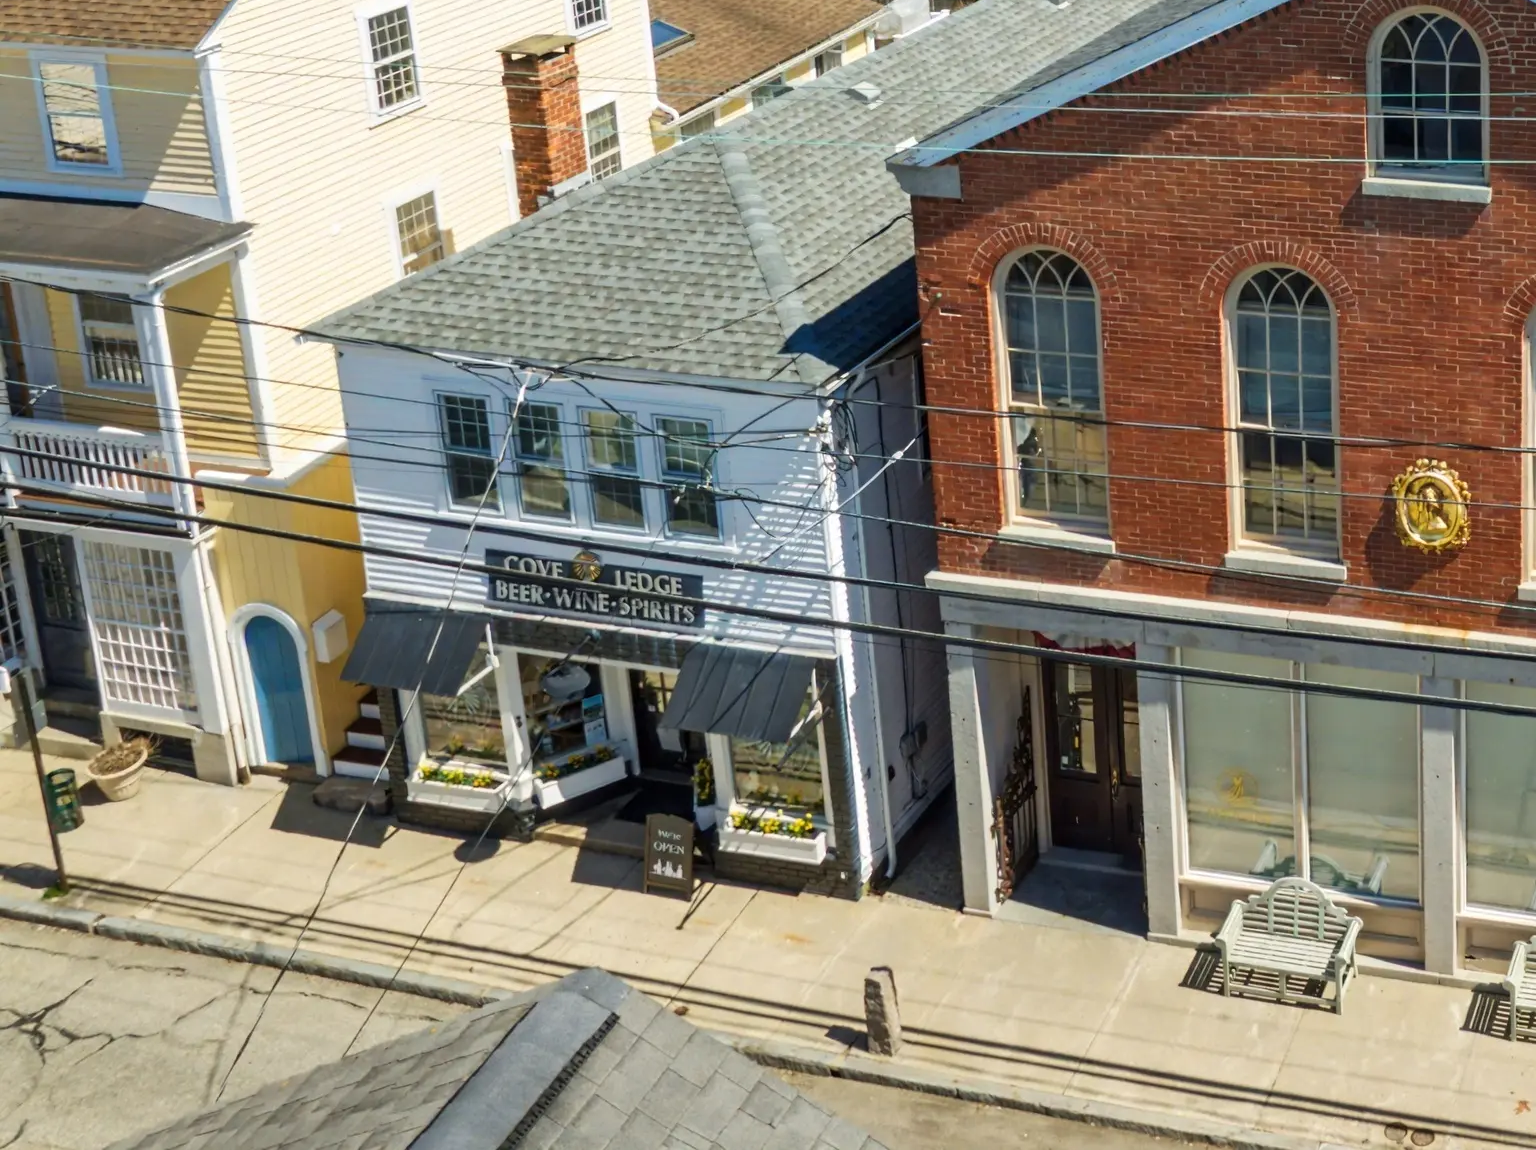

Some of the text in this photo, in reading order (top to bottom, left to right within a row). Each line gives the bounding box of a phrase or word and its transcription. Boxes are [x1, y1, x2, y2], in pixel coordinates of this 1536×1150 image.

[504, 555, 683, 596] COVE LEDGE
[653, 841, 684, 854] OPEN
